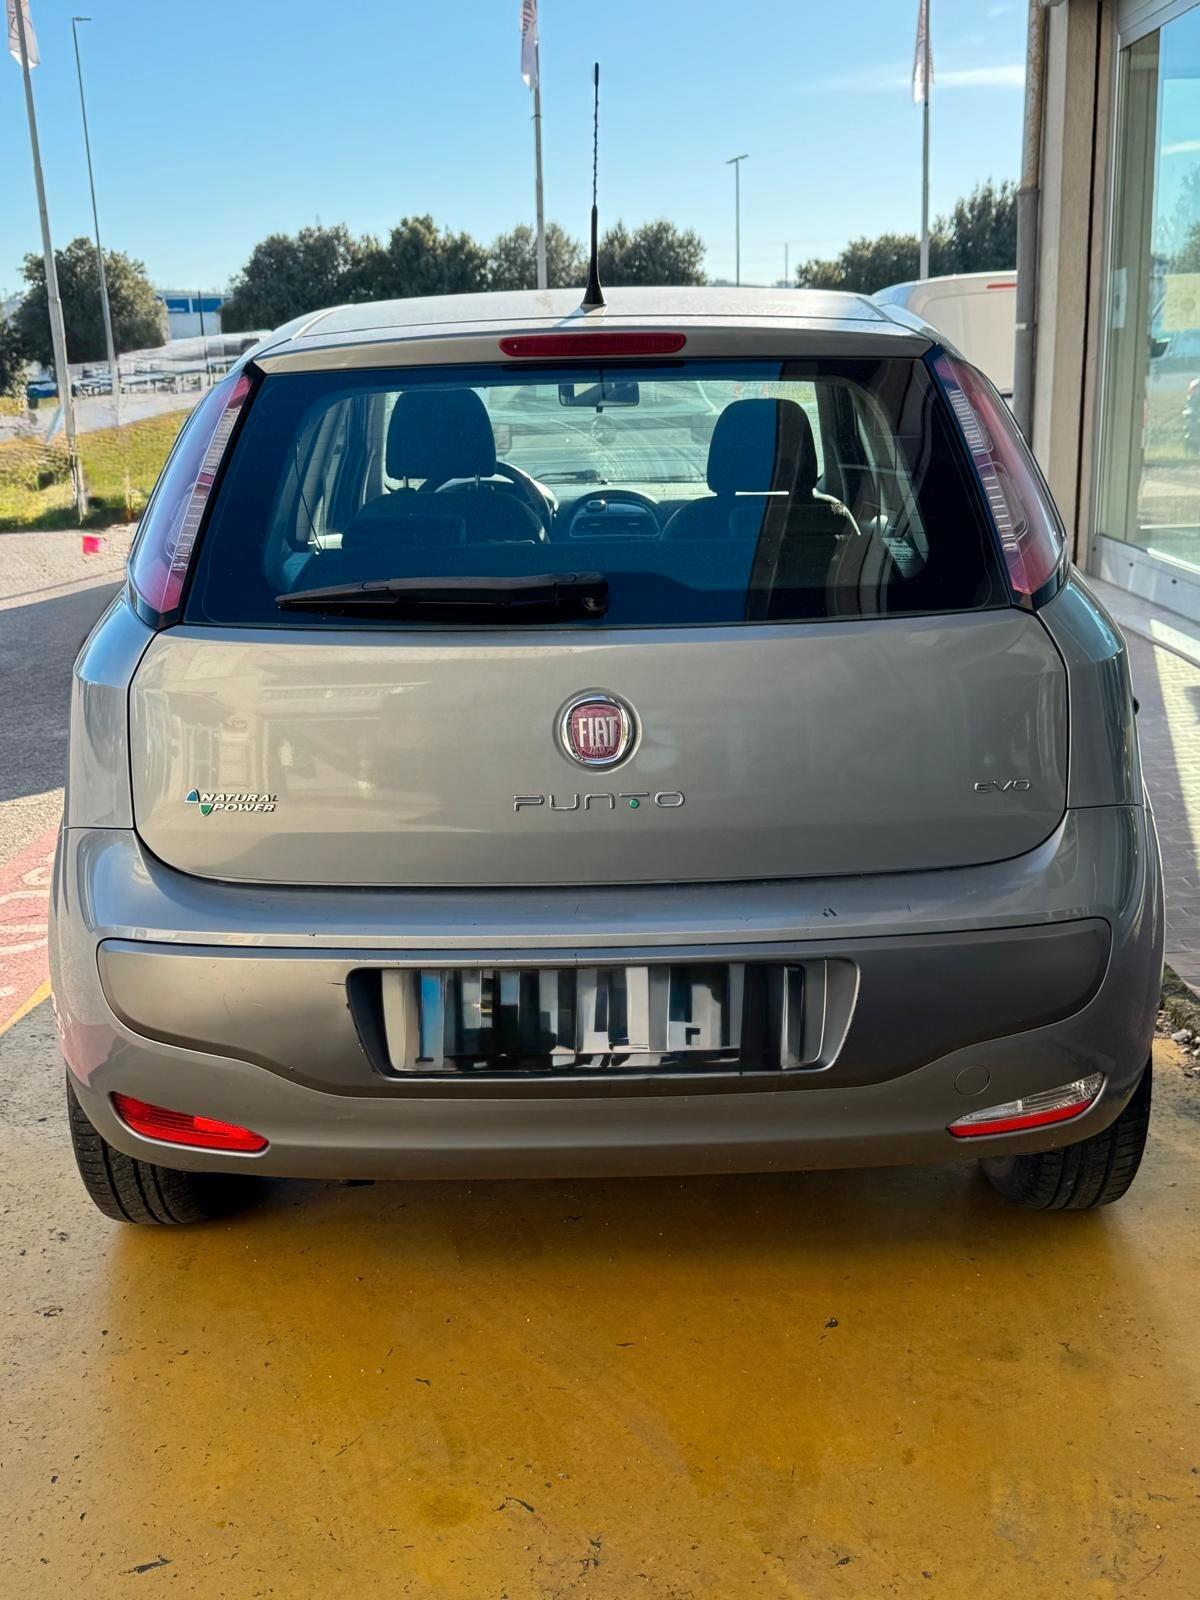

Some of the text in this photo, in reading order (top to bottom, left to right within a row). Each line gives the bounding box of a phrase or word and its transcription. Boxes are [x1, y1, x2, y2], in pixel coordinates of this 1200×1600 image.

[578, 716, 618, 748] FIAT
[974, 779, 1031, 793] EVO
[200, 793, 279, 803] NATURAL
[513, 791, 685, 812] PUNTO
[213, 803, 277, 813] POWER
